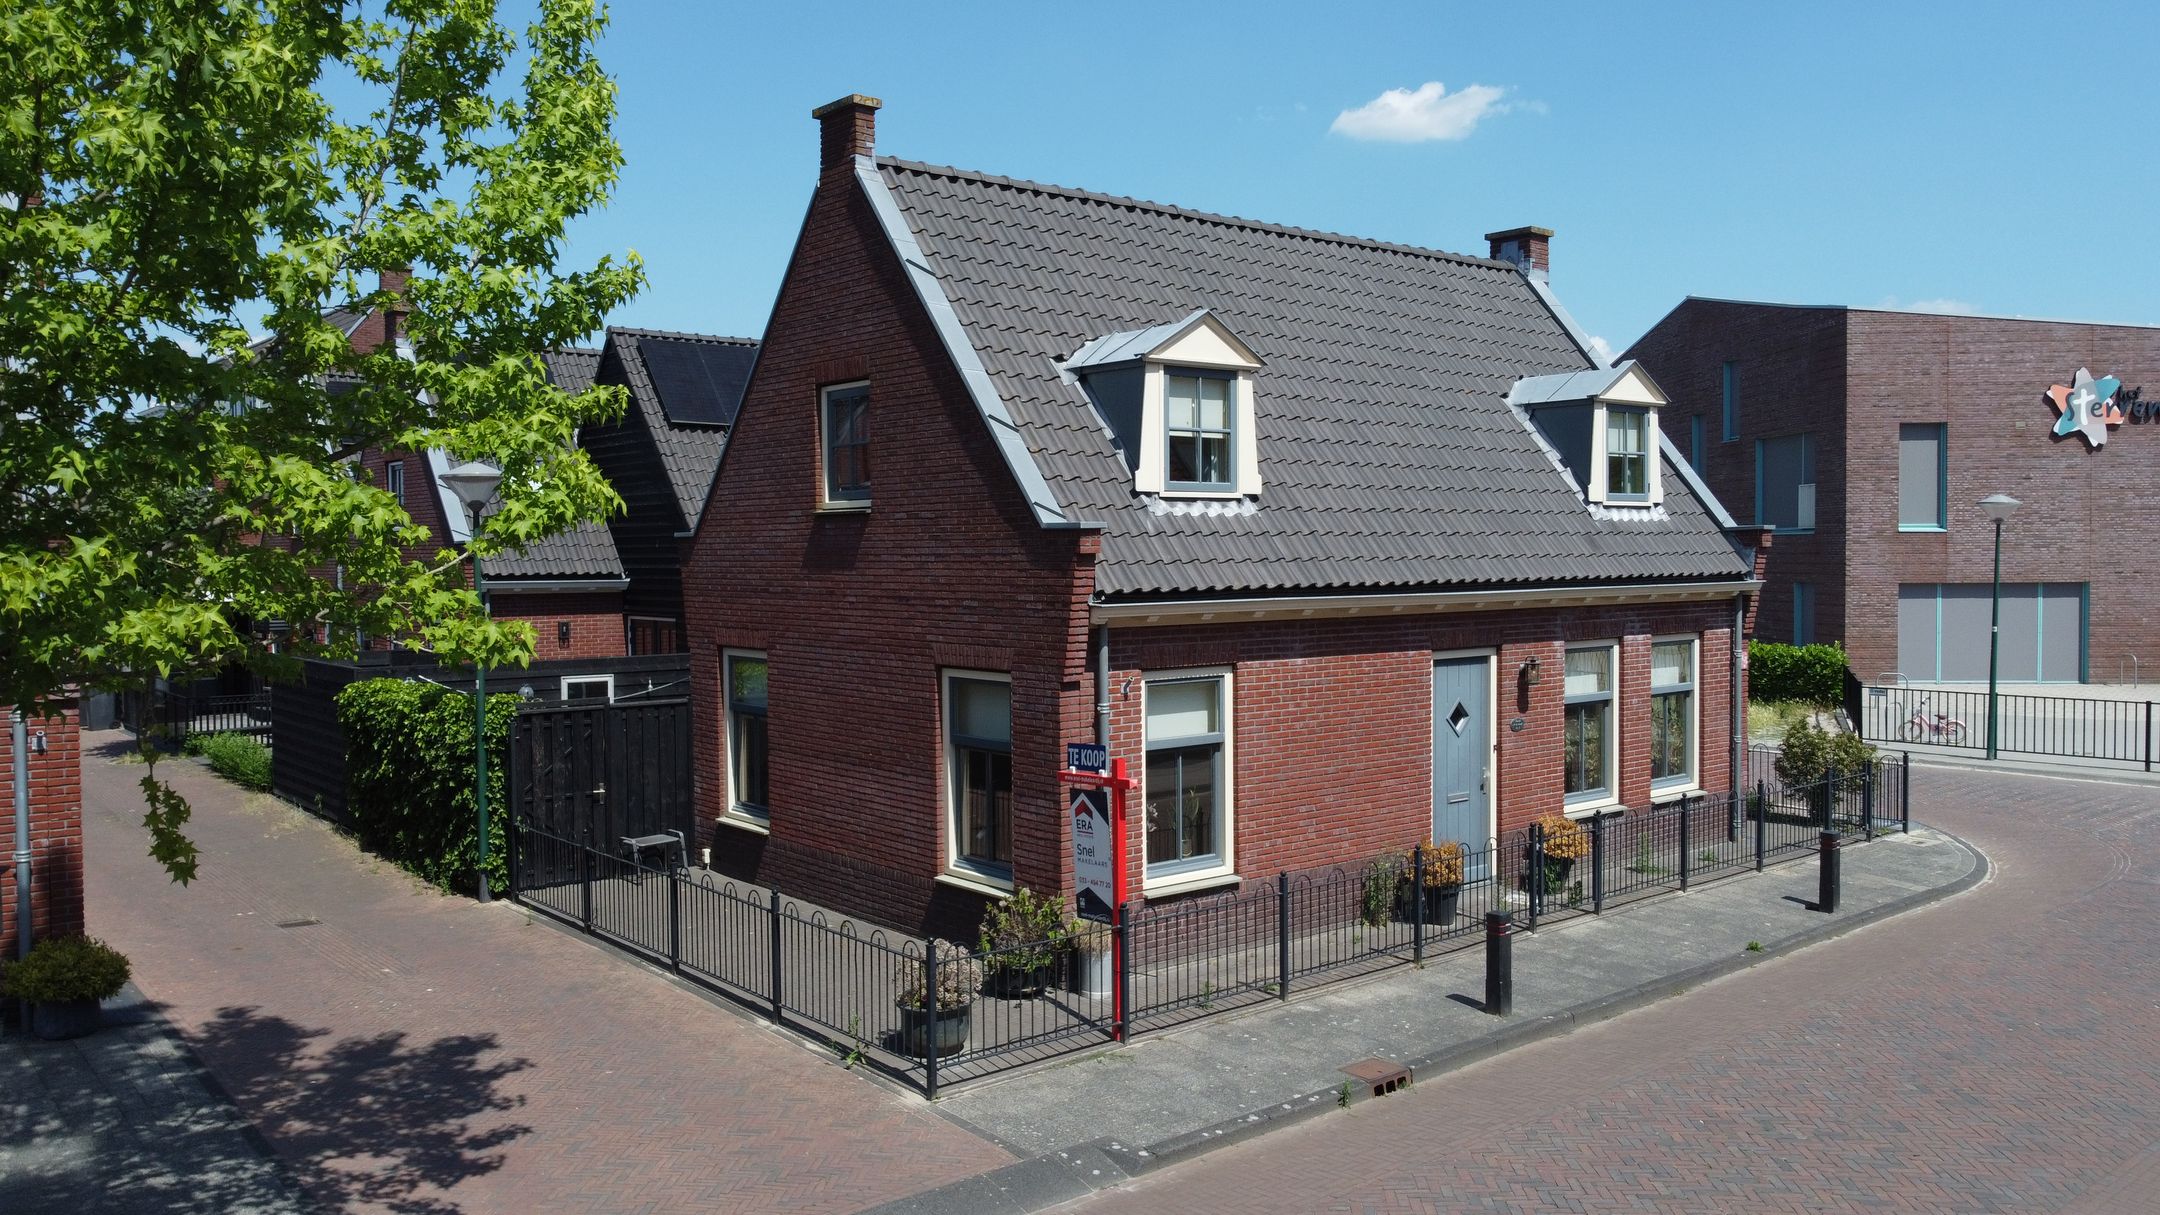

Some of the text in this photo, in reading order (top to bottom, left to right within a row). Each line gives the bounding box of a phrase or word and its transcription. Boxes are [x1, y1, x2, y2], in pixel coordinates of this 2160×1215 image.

[2117, 384, 2142, 402] het
[1068, 748, 1105, 767] TE KOOP
[1076, 819, 1093, 831] ERA
[1077, 844, 1095, 857] Snel
